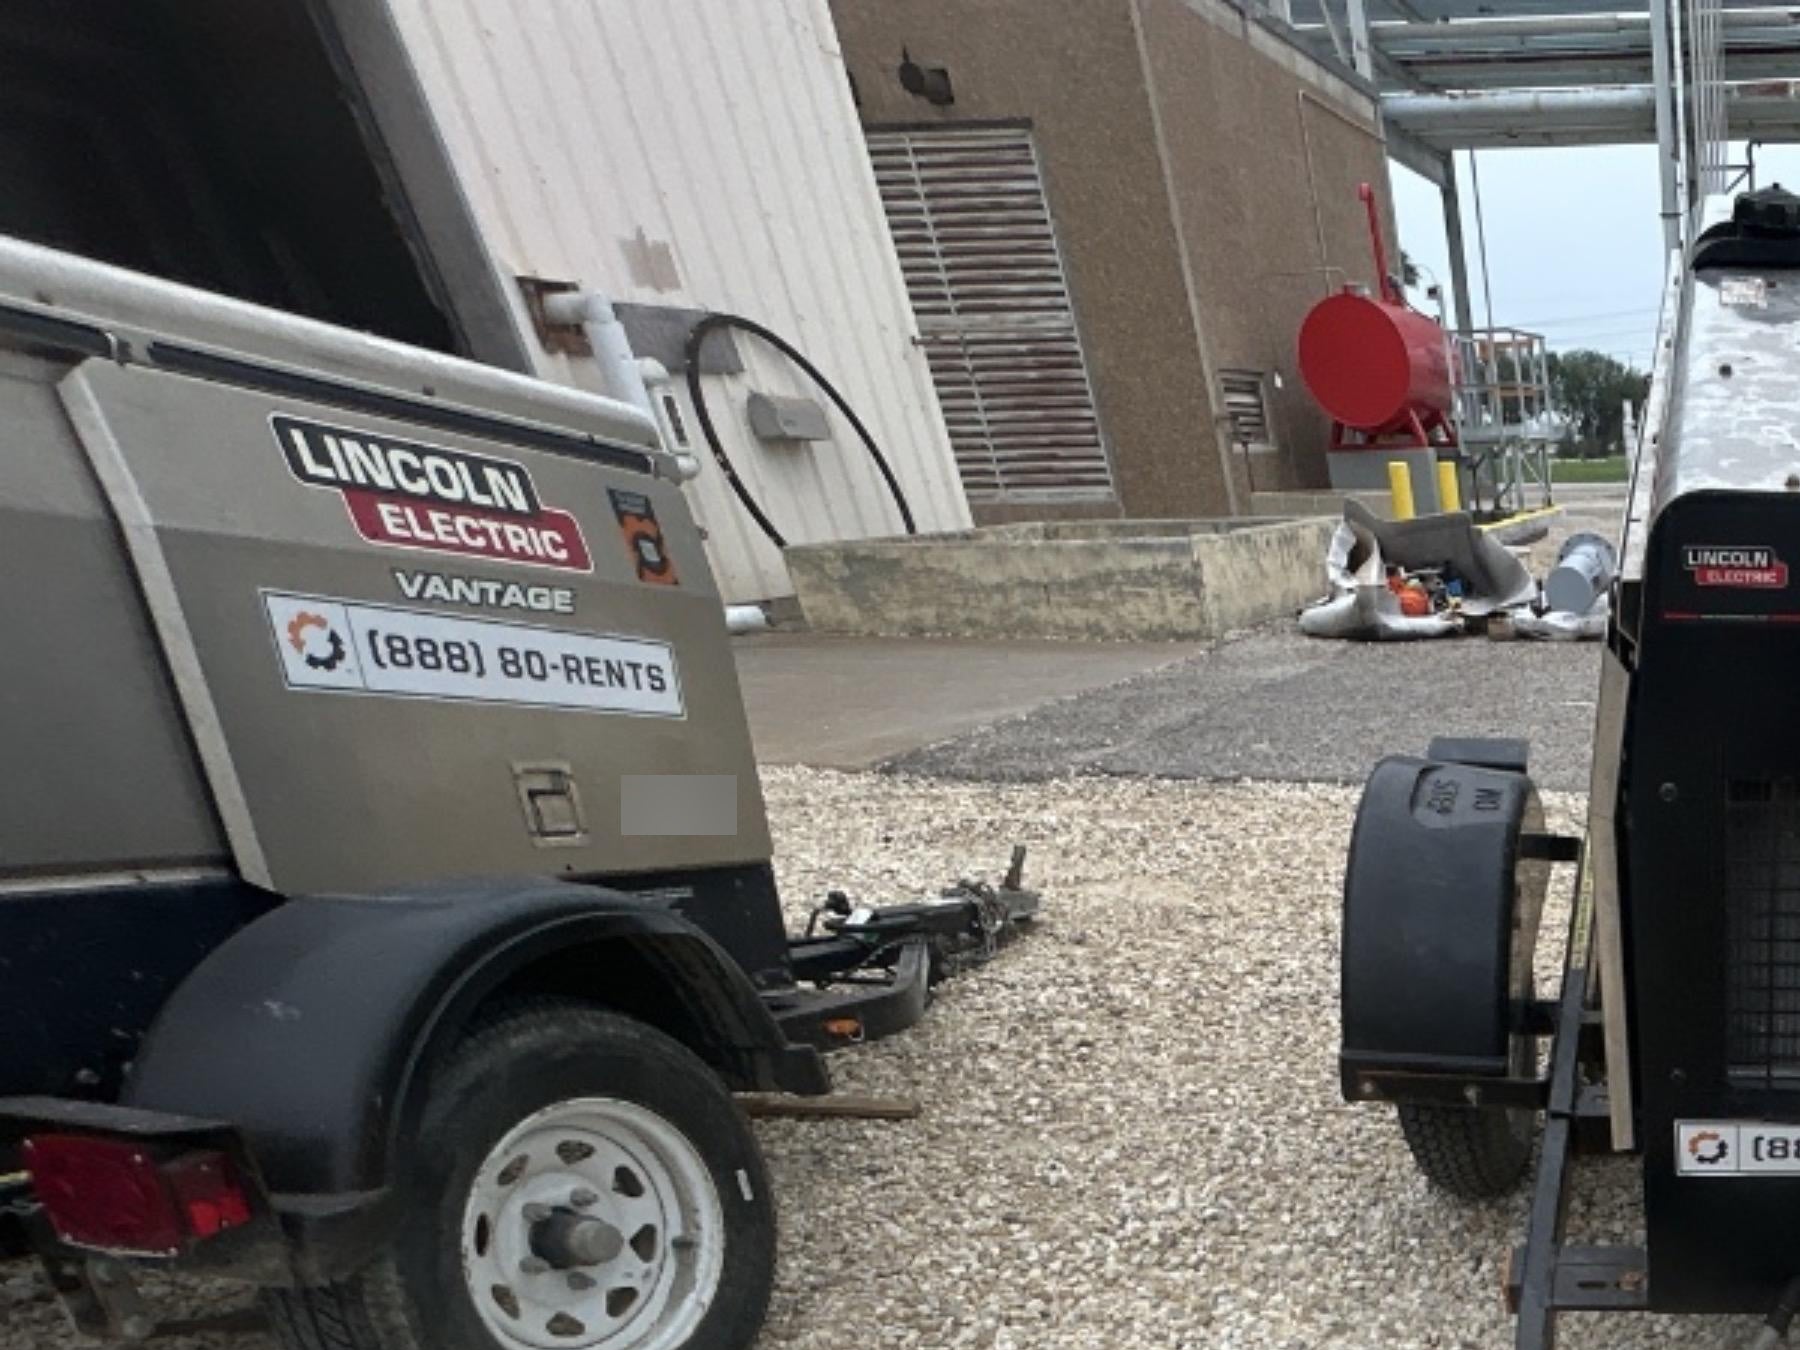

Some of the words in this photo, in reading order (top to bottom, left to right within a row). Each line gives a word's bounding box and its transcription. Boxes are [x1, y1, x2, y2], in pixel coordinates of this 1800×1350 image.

[289, 428, 531, 511] LINCOLN
[377, 503, 569, 561] ELECTRIC
[1687, 550, 1769, 567] LINCOLN
[1706, 569, 1778, 584] ELECTRIC
[395, 571, 575, 613] VANTAGE
[366, 628, 486, 679] (888)
[499, 646, 667, 694] 80-RENTS
